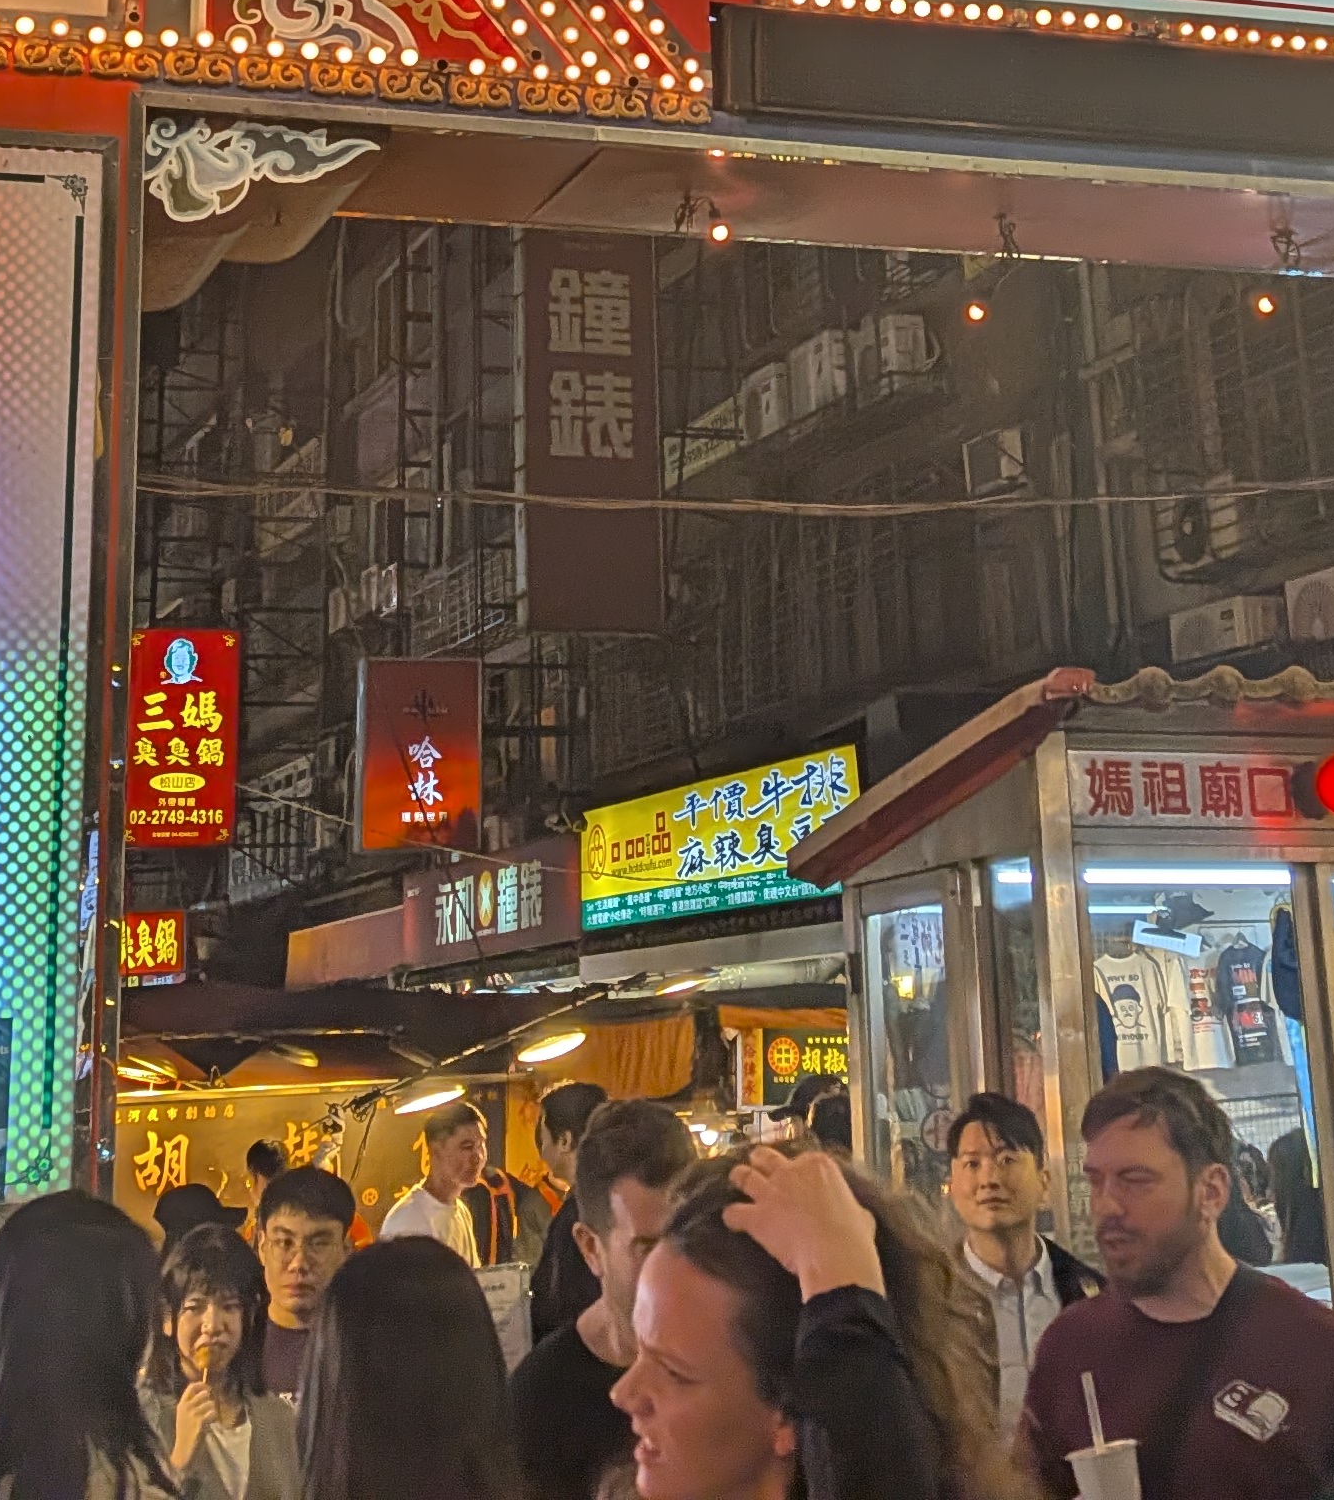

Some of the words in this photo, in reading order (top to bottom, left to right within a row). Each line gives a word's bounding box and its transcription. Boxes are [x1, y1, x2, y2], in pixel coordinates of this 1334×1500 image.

[548, 268, 634, 459] 鐘錶
[137, 691, 223, 733] 三媽
[133, 737, 224, 767] 臭臭鍋
[160, 777, 195, 788] 松山店
[675, 755, 849, 828] 平價牛排
[1084, 758, 1294, 819] 媽祖廟口
[130, 808, 223, 825] 02-2749-4316
[677, 804, 843, 879] 麻辣臭豆
[435, 874, 475, 947] 永和
[497, 858, 542, 935] 鐘錶
[802, 1047, 848, 1075] 胡椒
